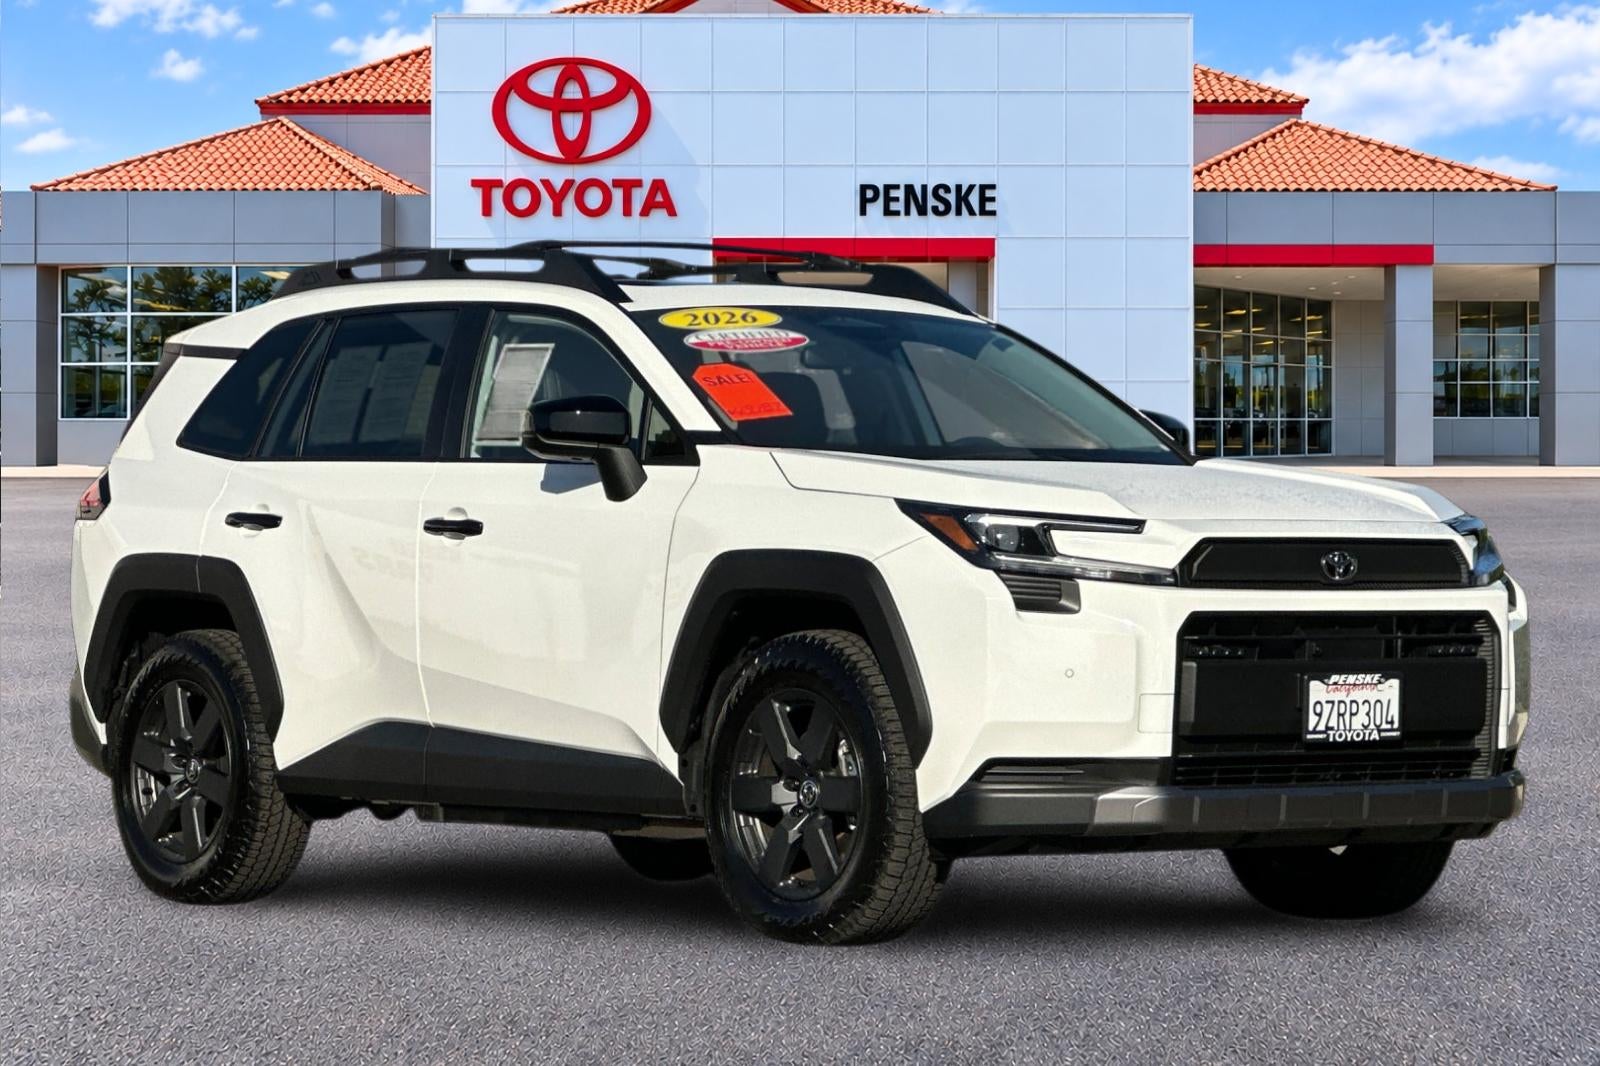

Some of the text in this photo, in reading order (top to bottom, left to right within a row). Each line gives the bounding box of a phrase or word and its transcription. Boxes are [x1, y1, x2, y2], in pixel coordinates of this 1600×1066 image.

[471, 178, 677, 218] TOYOTA
[858, 183, 997, 217] PENSKE
[684, 310, 758, 327] 2026
[1328, 674, 1382, 684] PENSKE
[1313, 699, 1395, 731] 9ZRP304
[1327, 730, 1380, 742] TOYOTA
